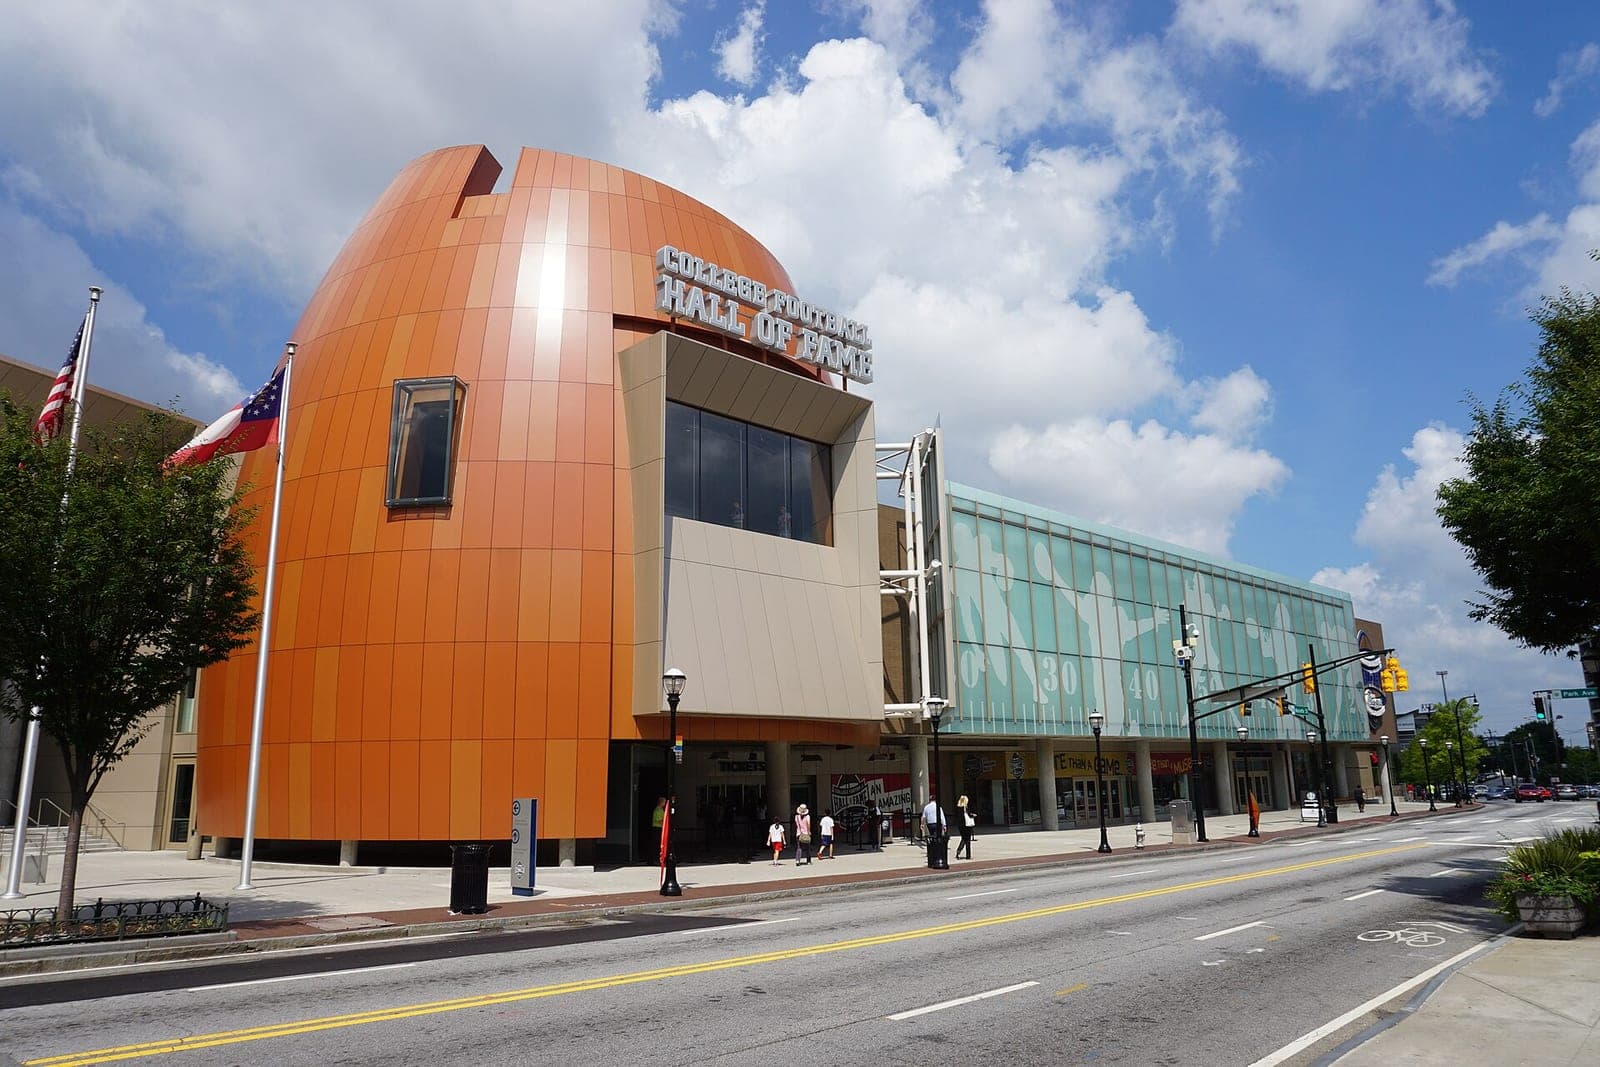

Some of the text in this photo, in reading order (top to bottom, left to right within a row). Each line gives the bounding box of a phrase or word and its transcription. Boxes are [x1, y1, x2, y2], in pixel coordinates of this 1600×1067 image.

[657, 245, 872, 350] COLLEGE FOOTBALL
[656, 274, 873, 383] HALL OF FAME
[1043, 656, 1077, 695] 30
[1129, 668, 1159, 700] 40
[871, 783, 882, 796] AN
[879, 791, 911, 809] AMAZING
